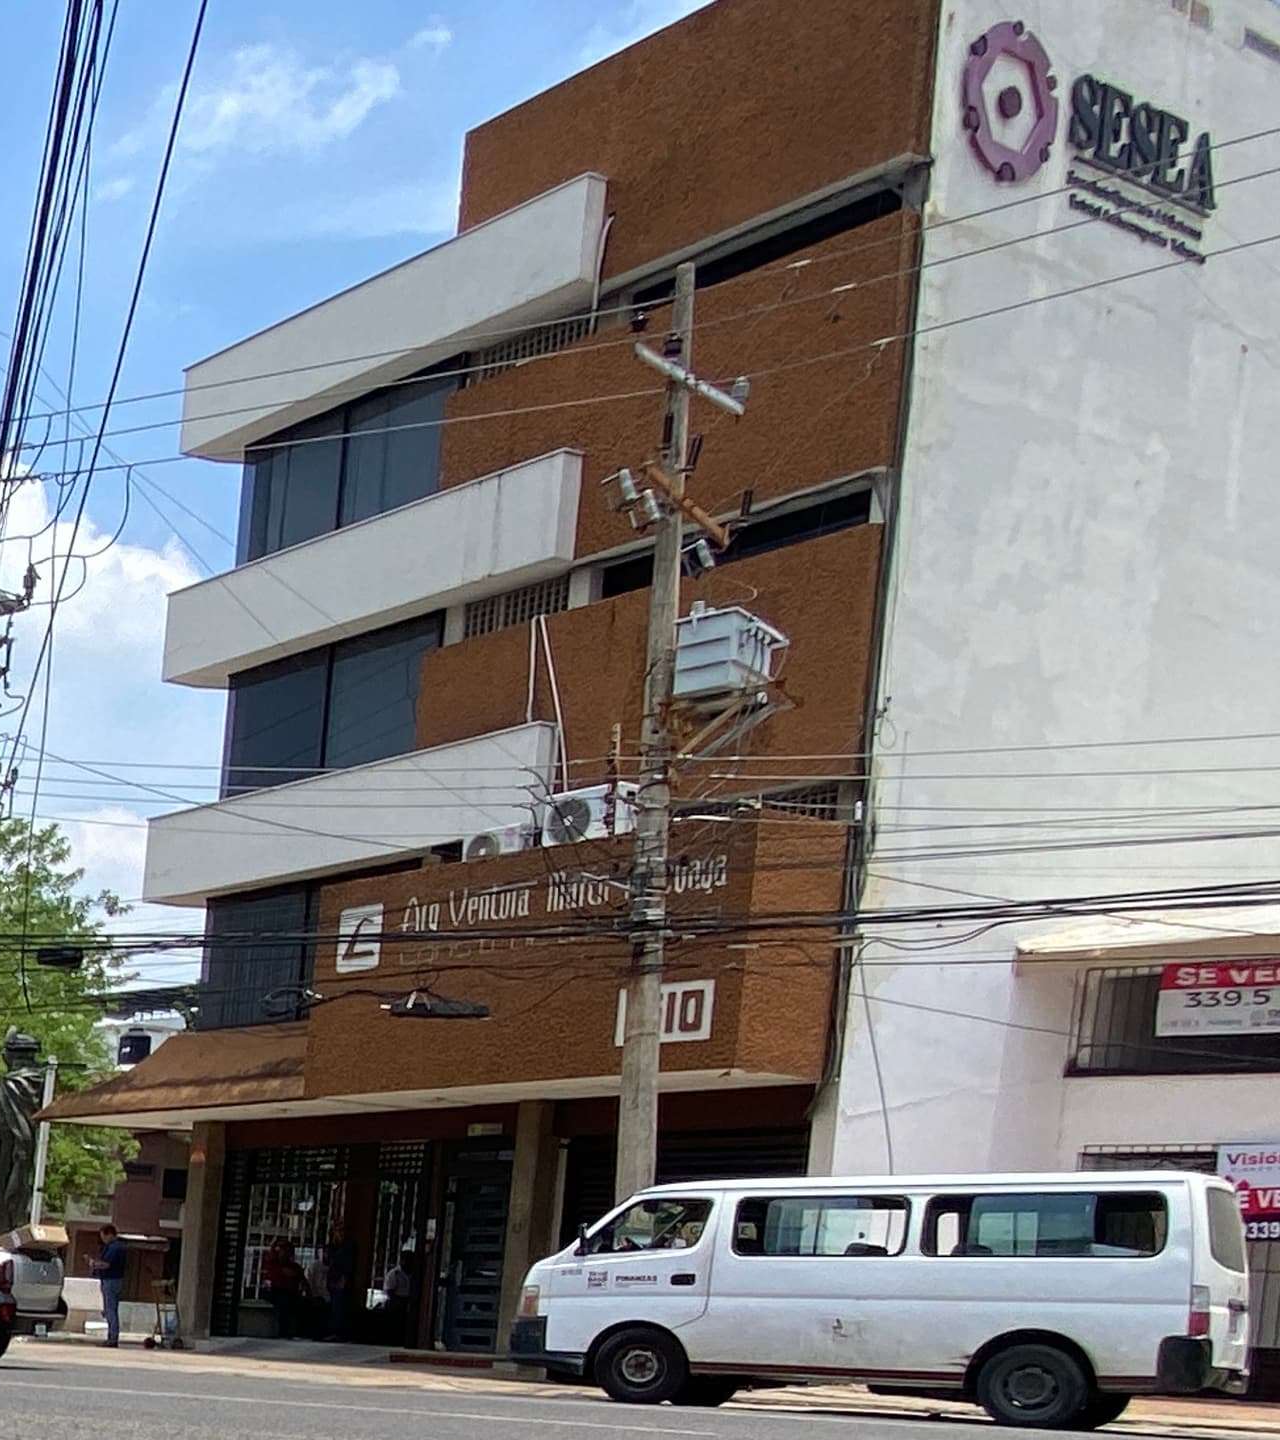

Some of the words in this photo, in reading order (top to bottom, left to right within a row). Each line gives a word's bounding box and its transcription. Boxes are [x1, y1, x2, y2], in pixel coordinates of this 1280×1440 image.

[1067, 74, 1217, 211] SESEA
[449, 887, 530, 926] Ventura
[1174, 967, 1217, 986] SE
[1228, 966, 1280, 984] VE
[1227, 1151, 1280, 1165] Visió
